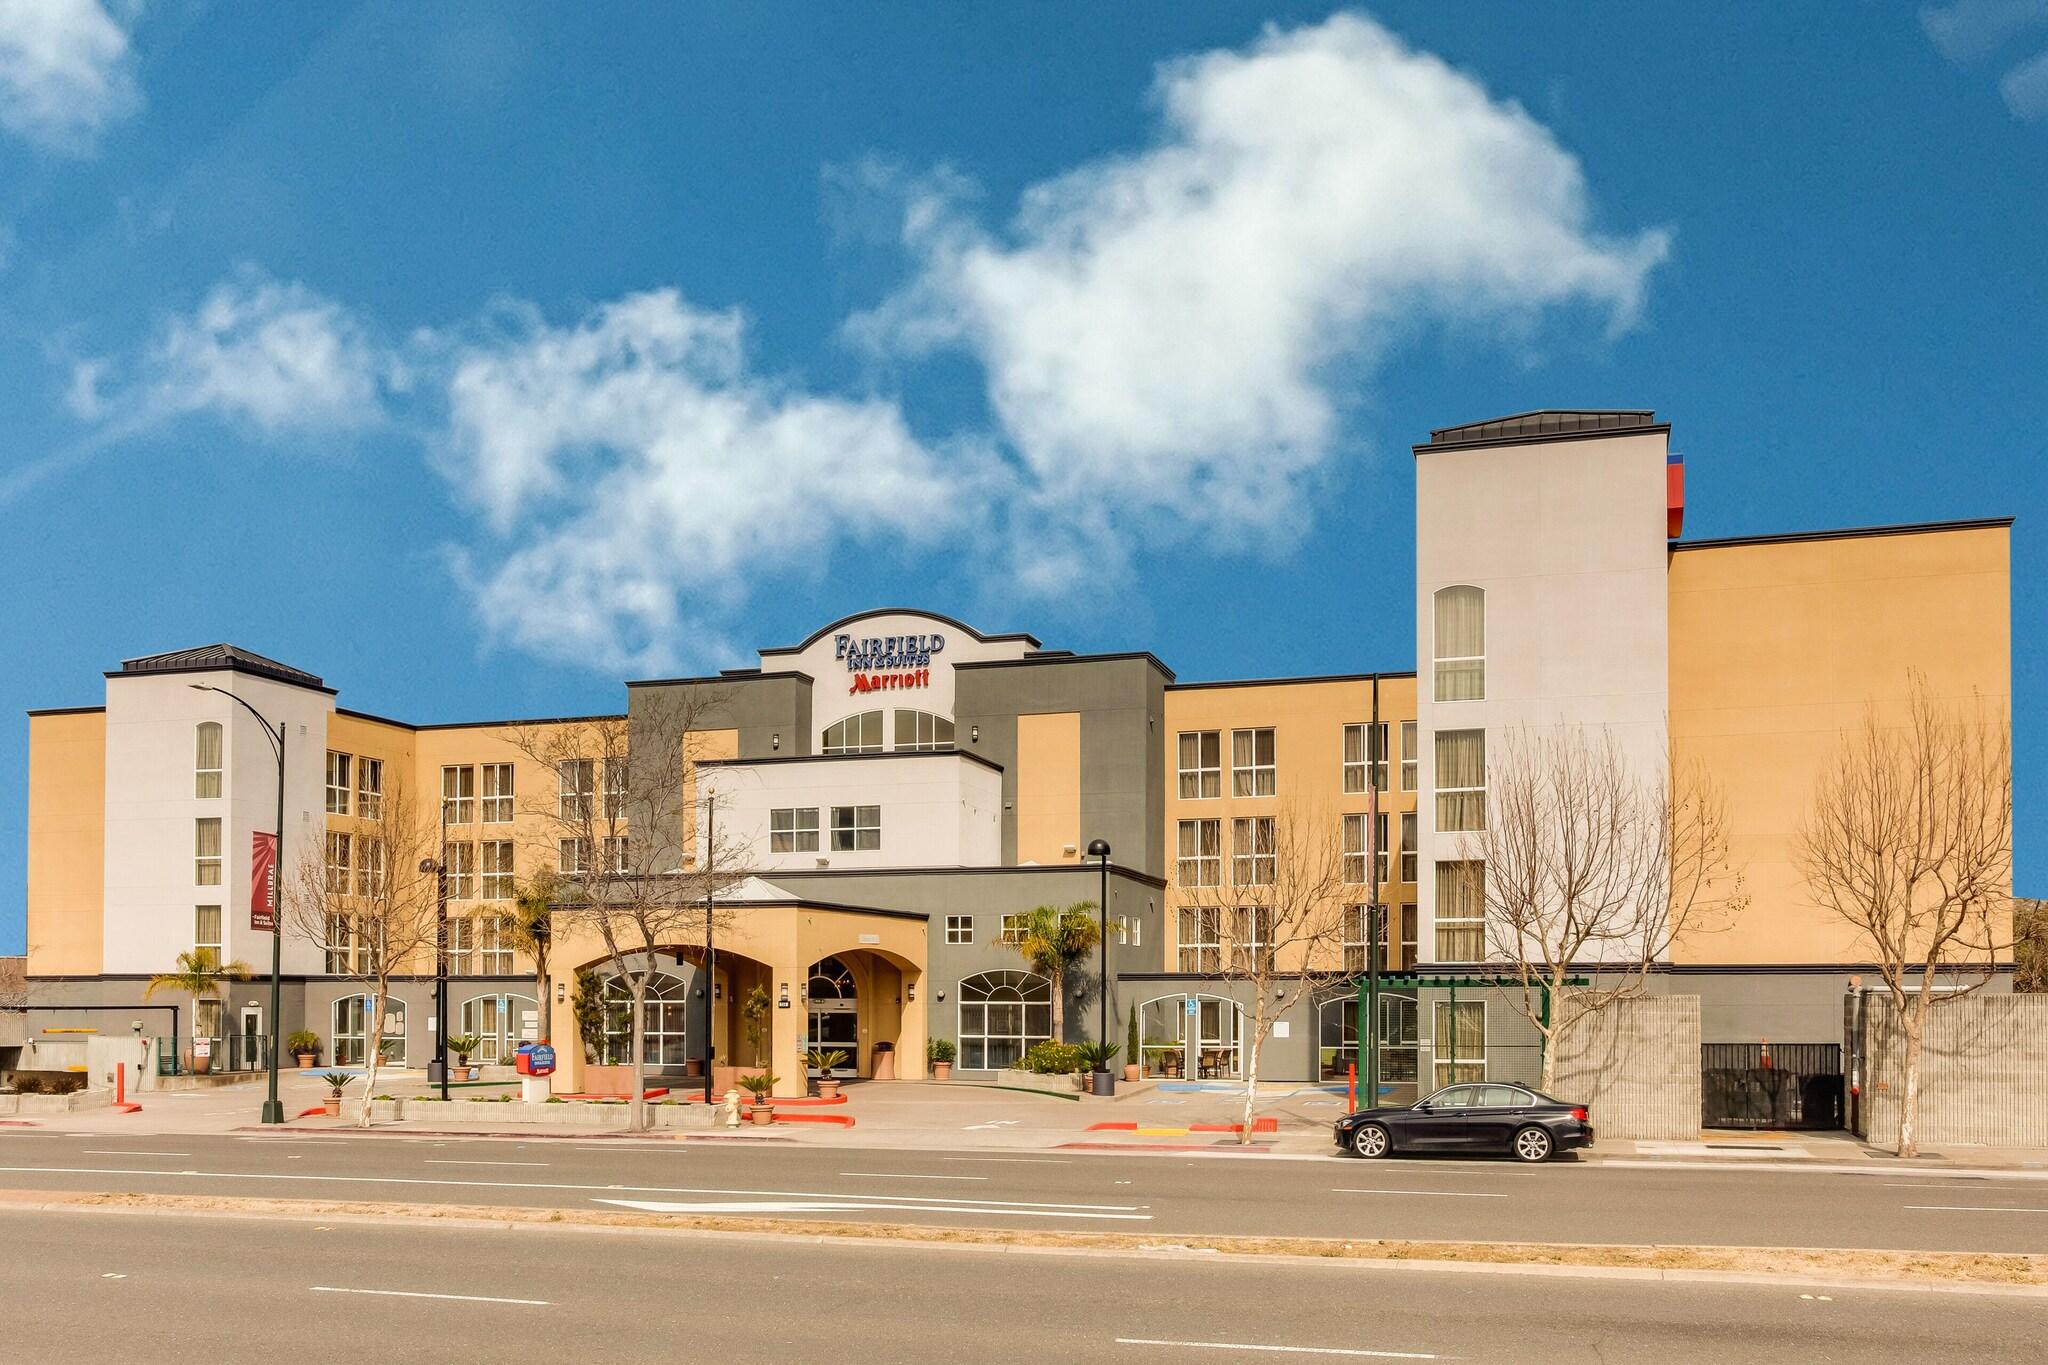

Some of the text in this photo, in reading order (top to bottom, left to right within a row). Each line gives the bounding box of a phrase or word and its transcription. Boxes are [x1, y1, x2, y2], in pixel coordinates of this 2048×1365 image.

[834, 634, 945, 658] FAIRFIELD
[848, 653, 930, 670] INN & SUITES
[849, 669, 930, 694] Marriott
